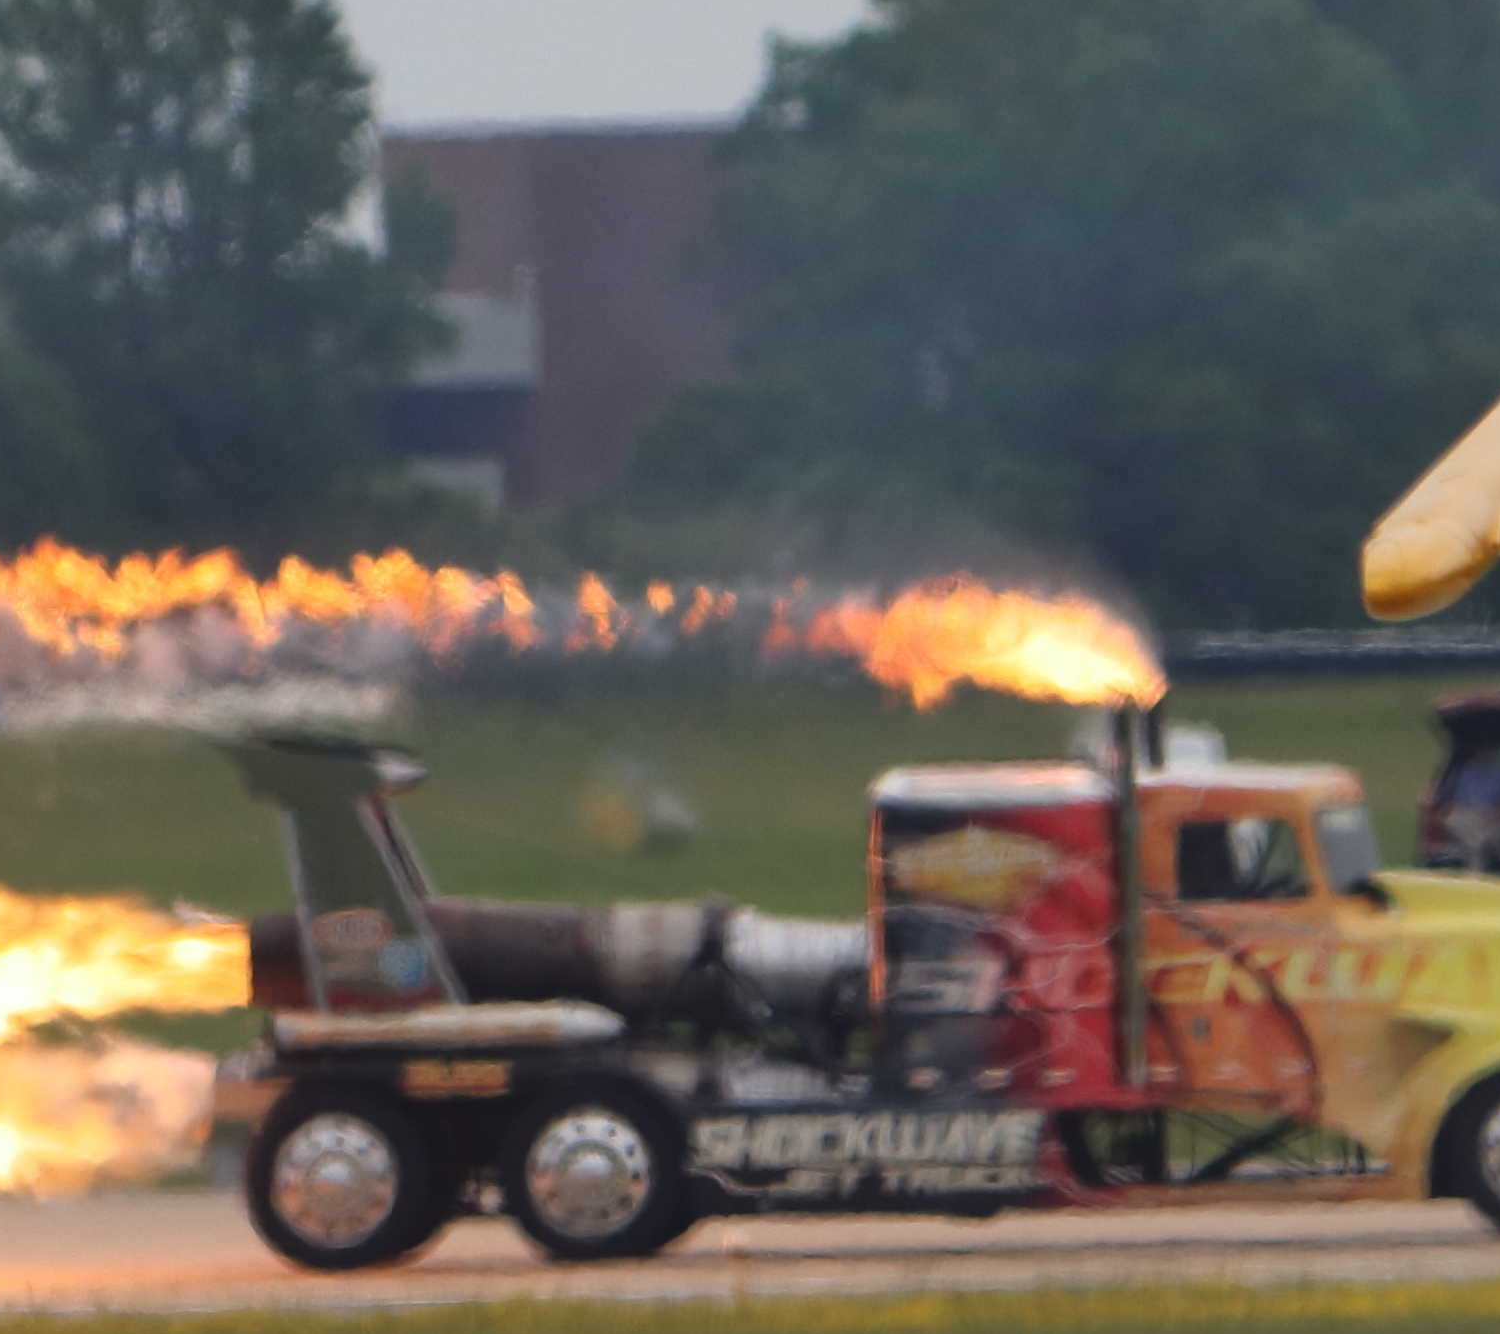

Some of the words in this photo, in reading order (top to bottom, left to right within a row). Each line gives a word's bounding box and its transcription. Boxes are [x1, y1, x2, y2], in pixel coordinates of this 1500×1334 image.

[690, 1112, 1043, 1167] SHOCKWAVE
[774, 1166, 863, 1197] JET
[879, 1164, 1037, 1193] TRUCK
